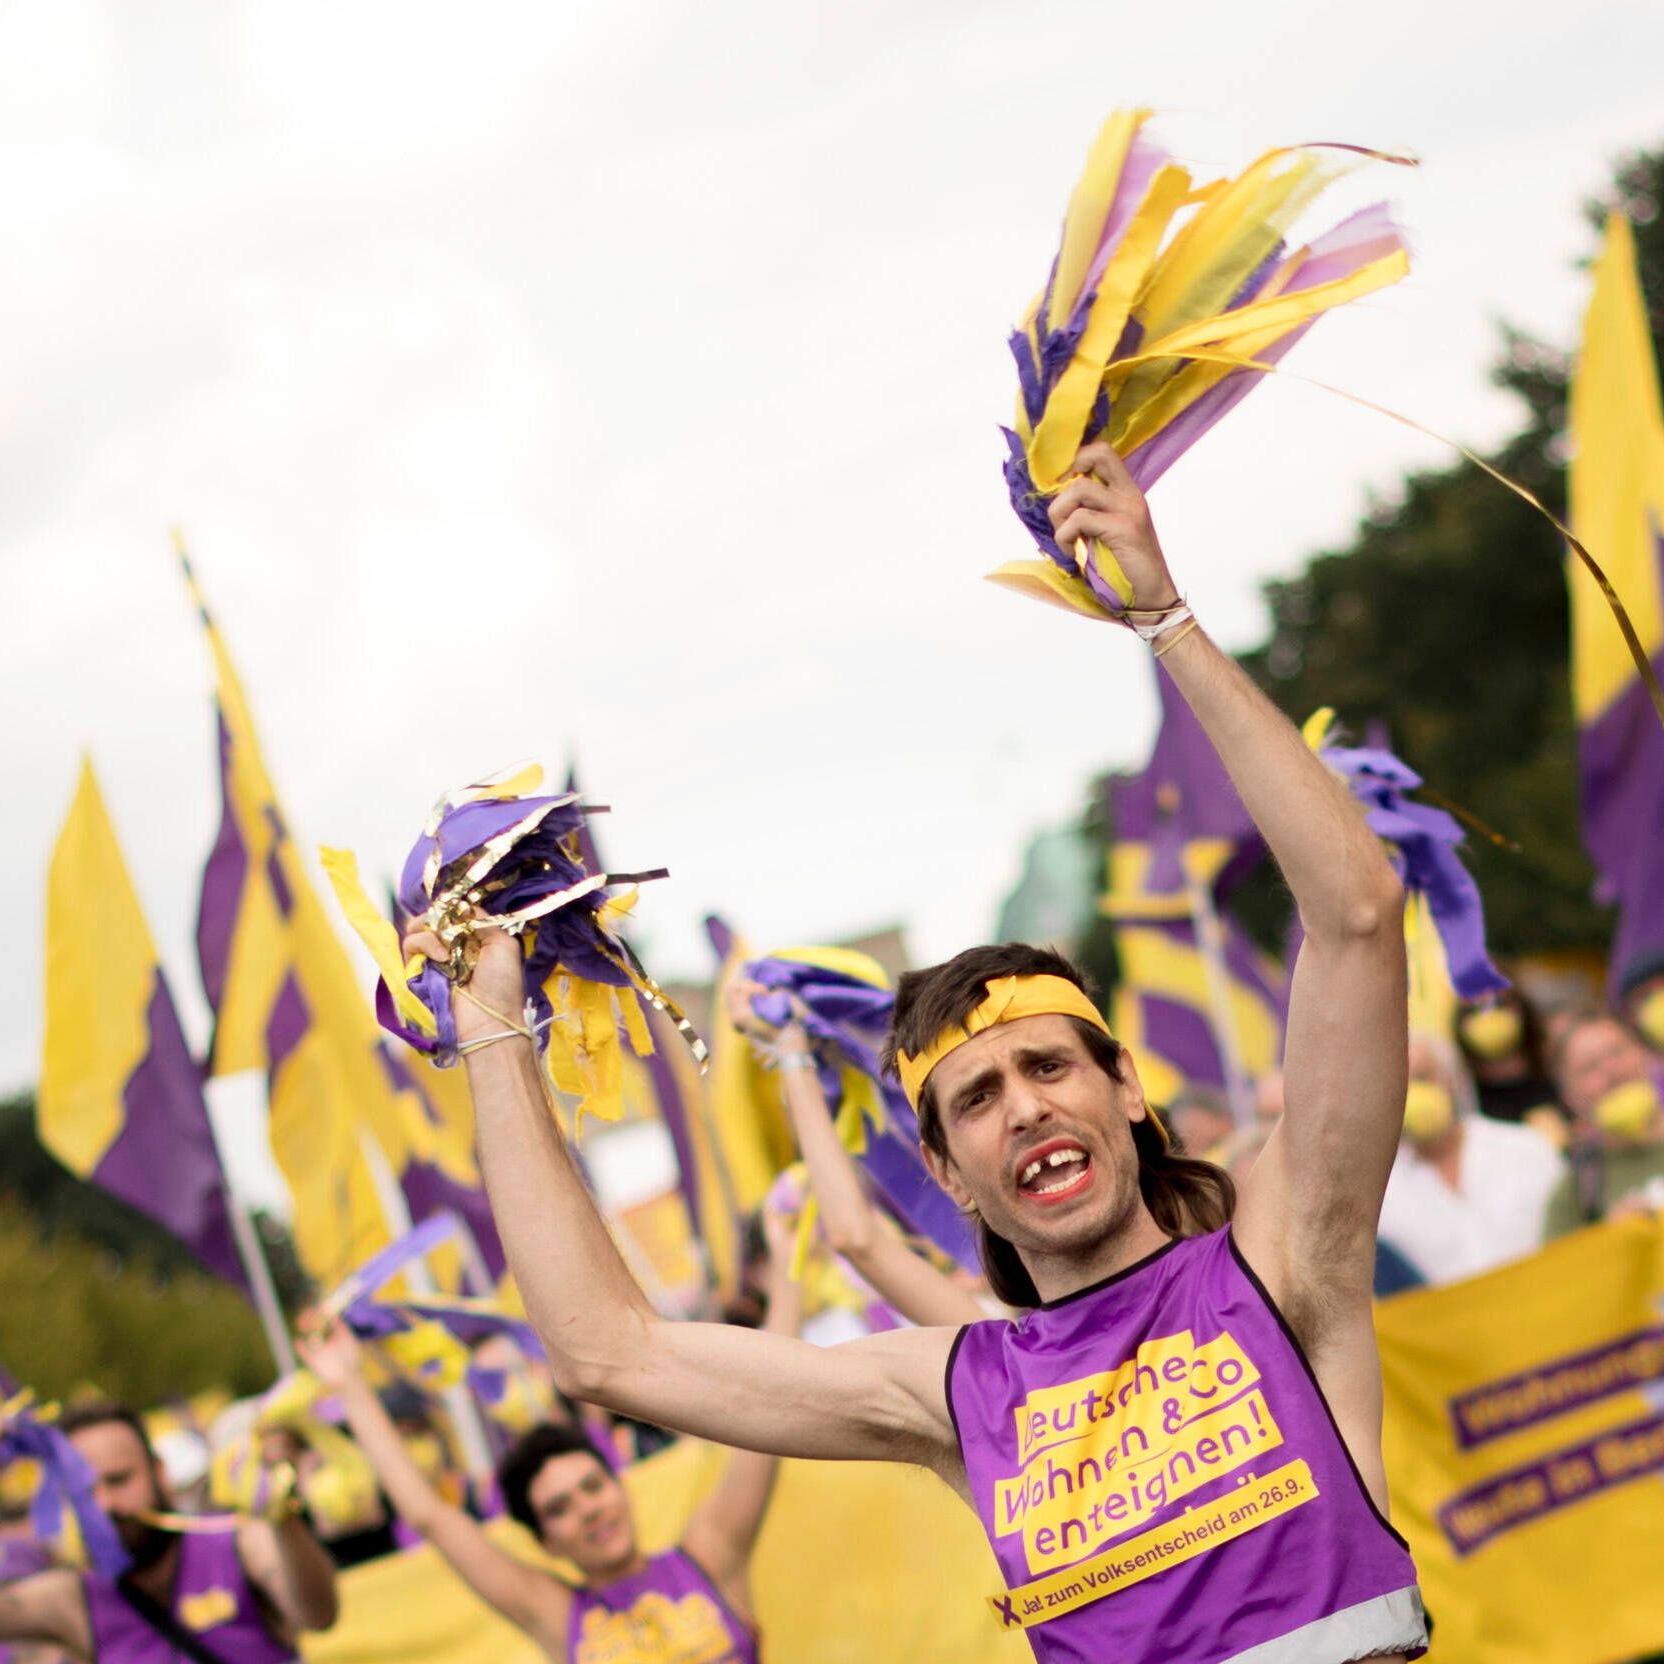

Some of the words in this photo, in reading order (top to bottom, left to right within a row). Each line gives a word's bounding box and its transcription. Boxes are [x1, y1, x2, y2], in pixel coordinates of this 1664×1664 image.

[1004, 1426, 1149, 1524] Wohnen
[1162, 1398, 1183, 1435] &
[1189, 1358, 1243, 1399] Co
[1035, 1399, 1267, 1555] enteignen!
[1047, 1582, 1085, 1607] zum
[1082, 1514, 1227, 1589] Volksentscheid
[1228, 1502, 1259, 1526] am
[1259, 1478, 1305, 1510] 26.9.
